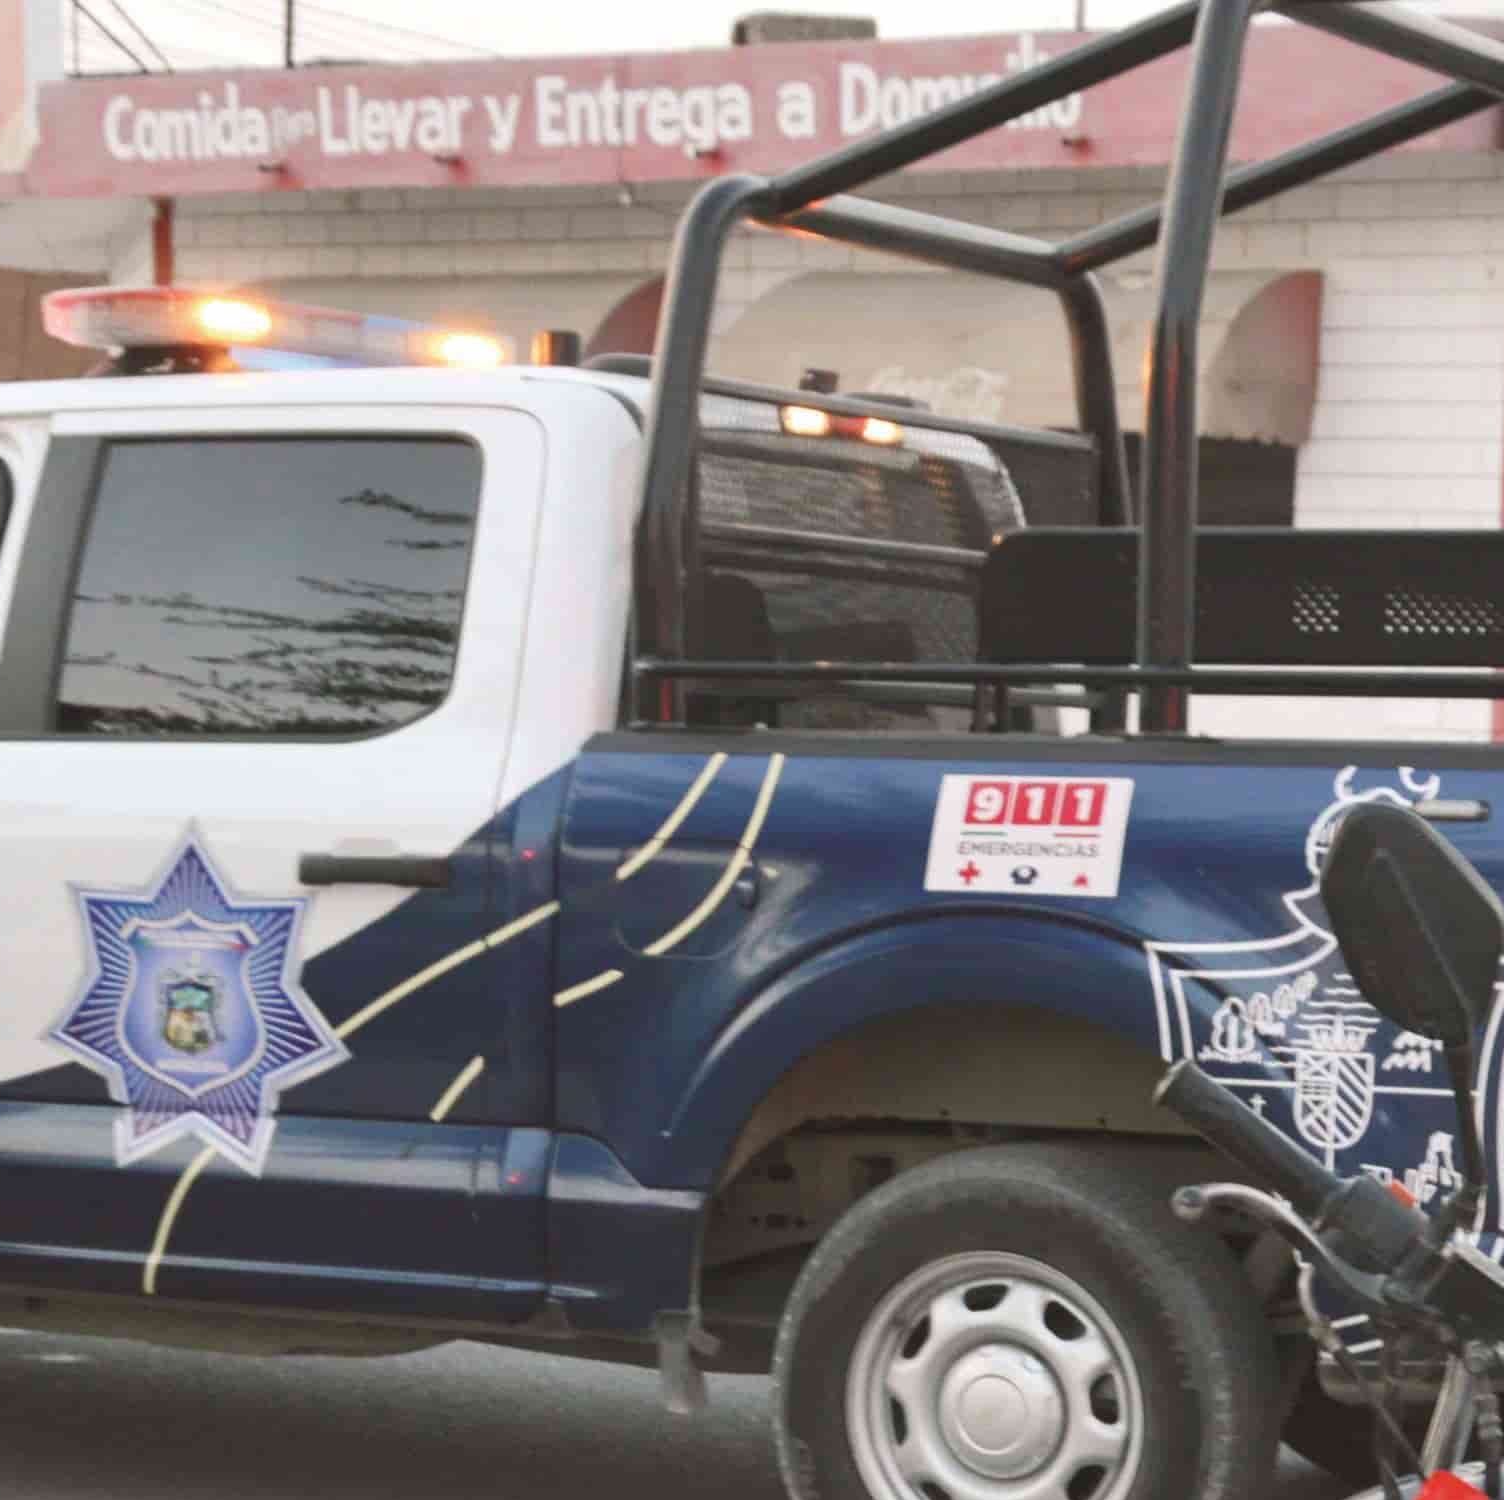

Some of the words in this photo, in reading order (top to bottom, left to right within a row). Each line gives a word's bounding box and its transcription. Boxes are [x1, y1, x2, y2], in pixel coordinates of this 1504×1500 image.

[103, 81, 271, 160] Comida
[315, 84, 470, 155] Llevar
[482, 94, 521, 154] y
[534, 76, 753, 159] Entrega
[776, 80, 817, 138] a
[969, 784, 1098, 823] 911
[957, 839, 1100, 858] EMERGENCIAS
